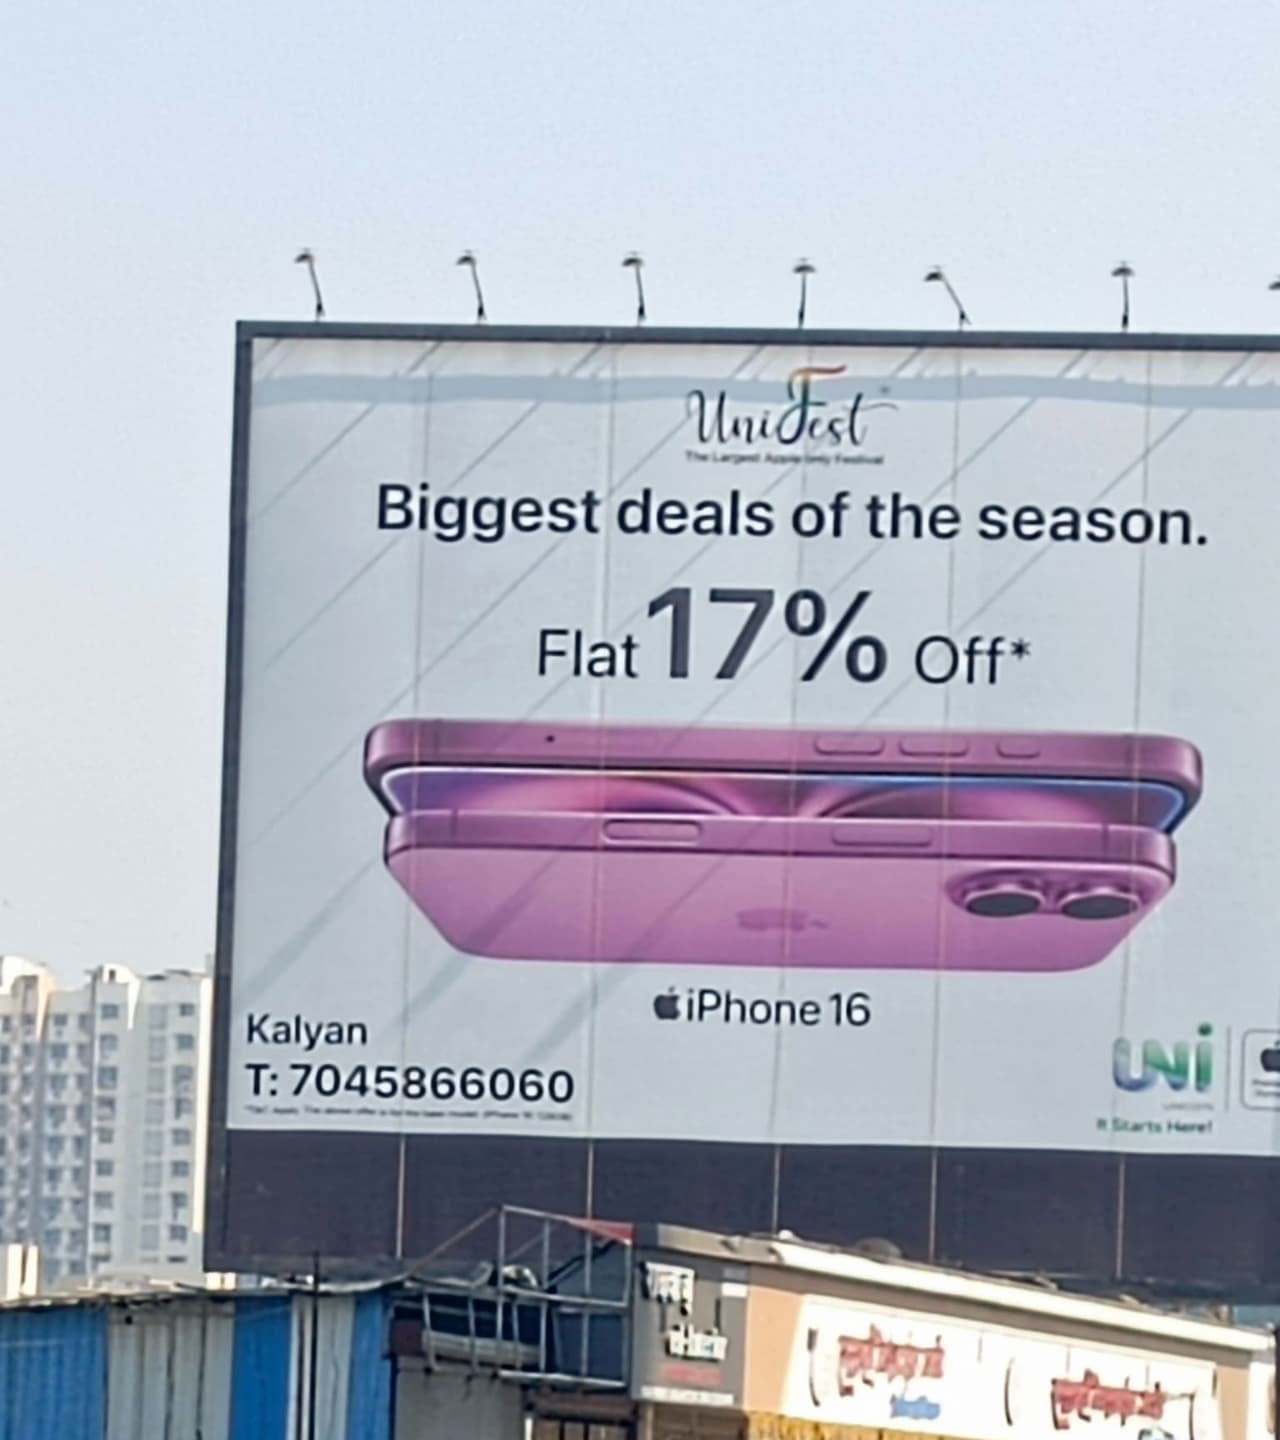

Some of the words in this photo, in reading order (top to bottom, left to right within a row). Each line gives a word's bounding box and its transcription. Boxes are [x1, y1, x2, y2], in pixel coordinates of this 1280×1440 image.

[376, 482, 600, 543] Biggest
[617, 487, 775, 537] deals
[791, 490, 851, 539] of
[865, 492, 961, 540] the
[977, 503, 1208, 546] season.
[537, 628, 640, 679] Flat
[646, 586, 888, 684] 17%
[686, 987, 822, 1026] iPhone
[828, 991, 872, 1027] 16
[246, 1013, 368, 1051] Kalyan
[244, 1063, 278, 1097] T:
[288, 1063, 576, 1104] 7045866060
[1112, 1118, 1163, 1133] Starts
[1166, 1120, 1214, 1134] Here!
